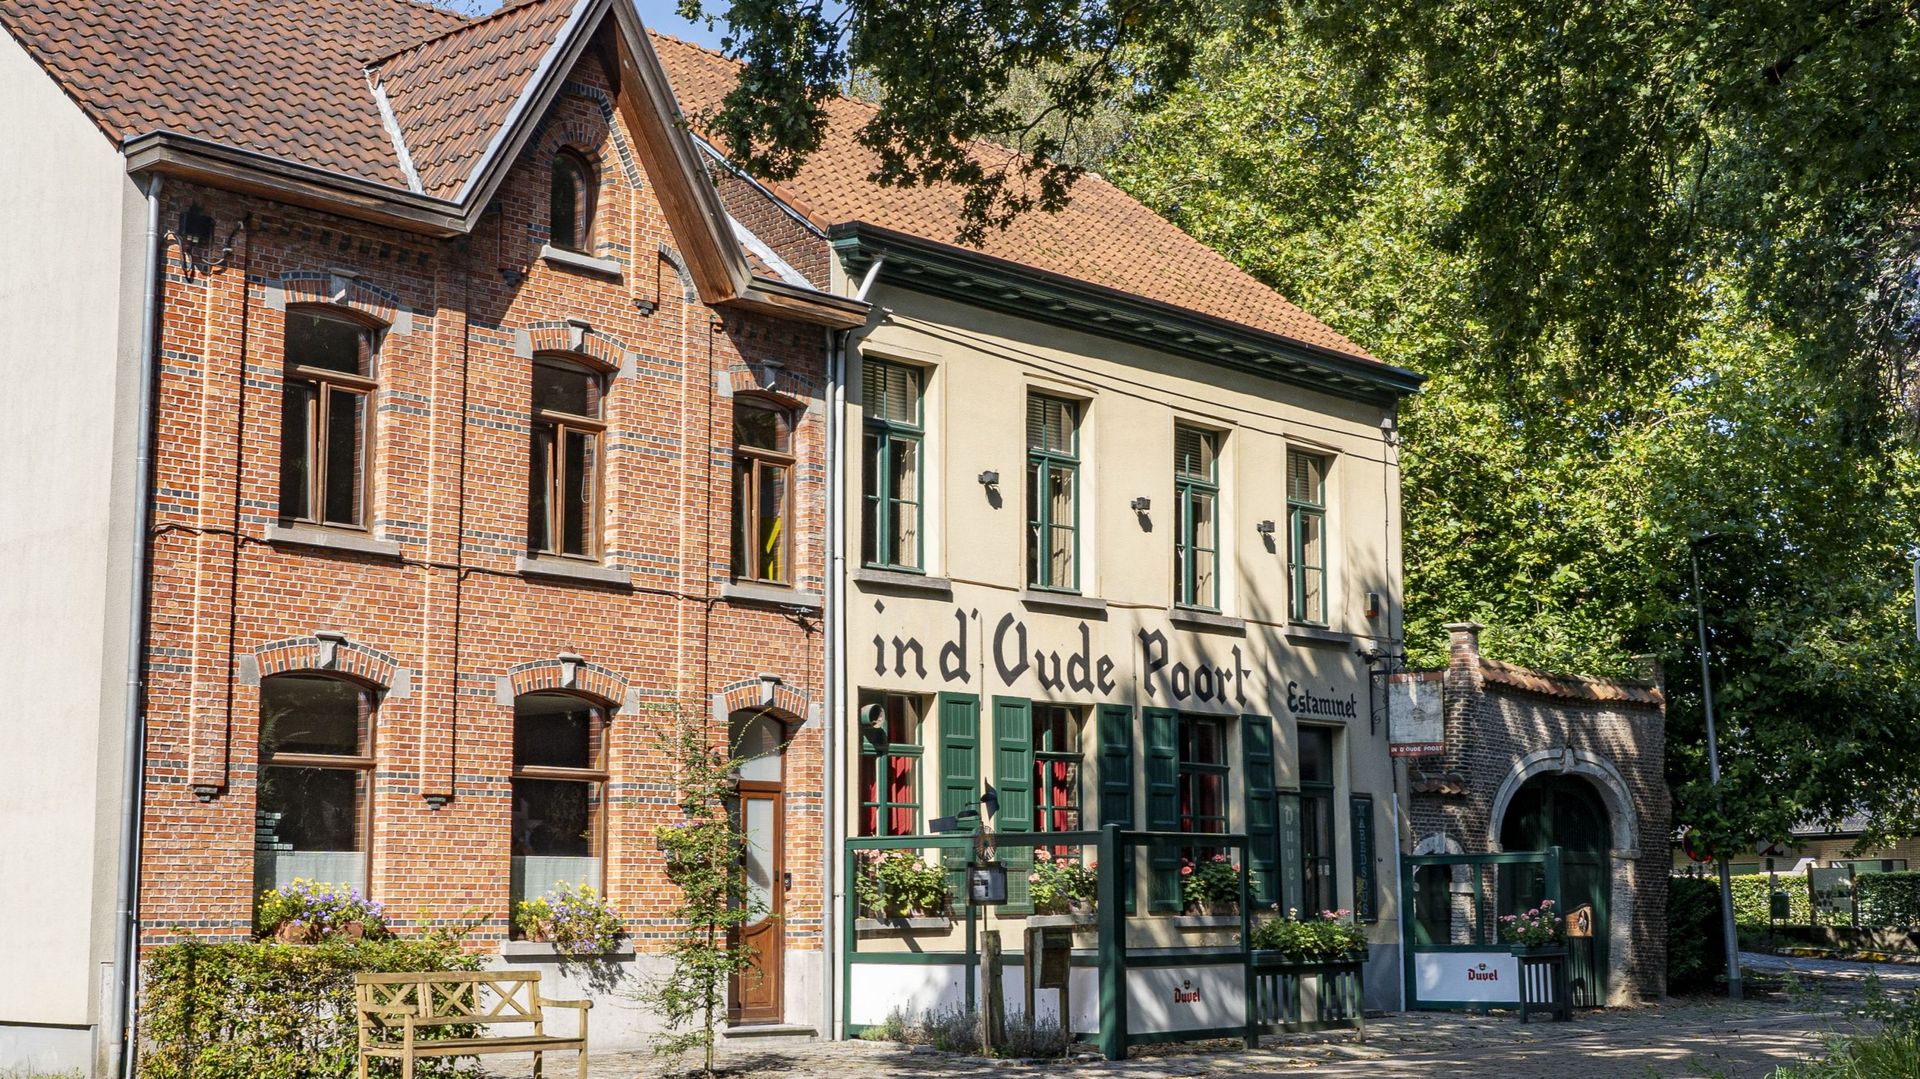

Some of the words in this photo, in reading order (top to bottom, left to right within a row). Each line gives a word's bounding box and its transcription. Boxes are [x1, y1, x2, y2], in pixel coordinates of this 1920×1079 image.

[1137, 627, 1253, 708] Poort
[1287, 680, 1357, 718] Estaminet
[1467, 967, 1498, 981] Duvel
[1174, 986, 1201, 1004] Duvel
